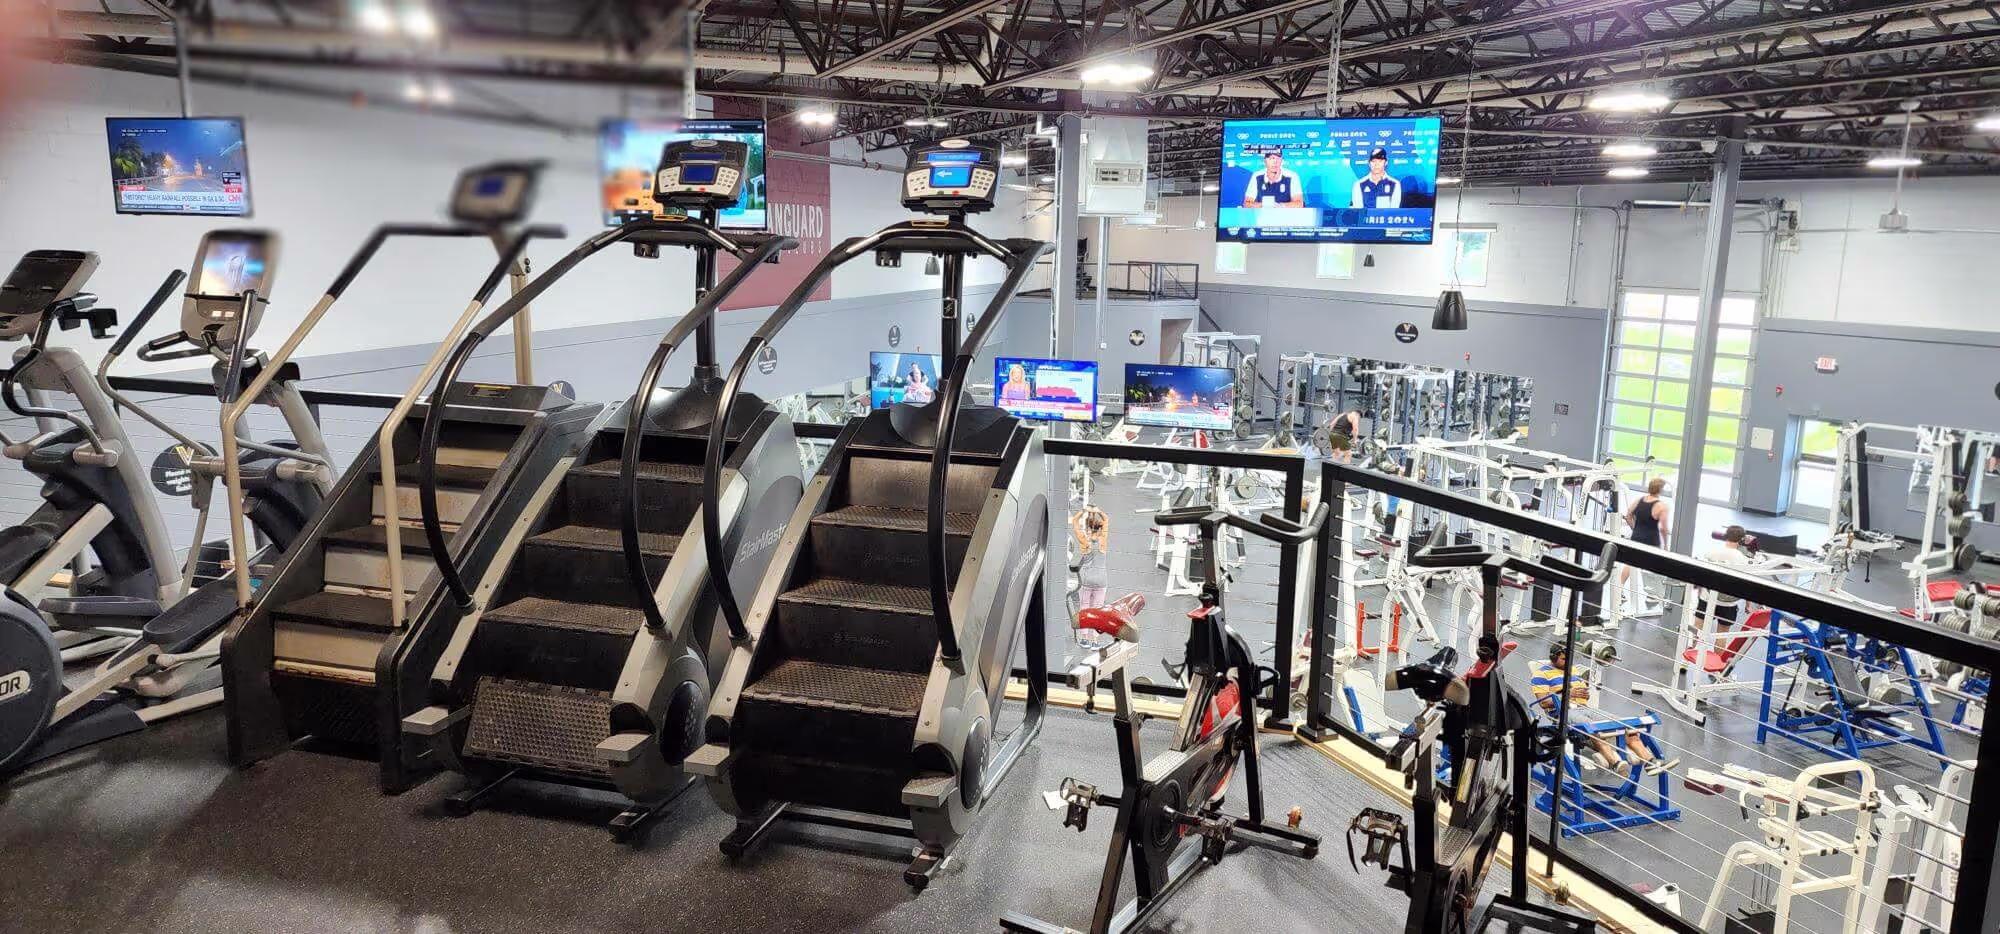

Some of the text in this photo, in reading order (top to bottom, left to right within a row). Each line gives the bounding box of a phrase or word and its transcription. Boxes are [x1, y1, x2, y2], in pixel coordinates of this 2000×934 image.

[767, 203, 823, 238] ANGUARD
[1387, 216, 1415, 224] 2024
[740, 523, 787, 562] StairMast
